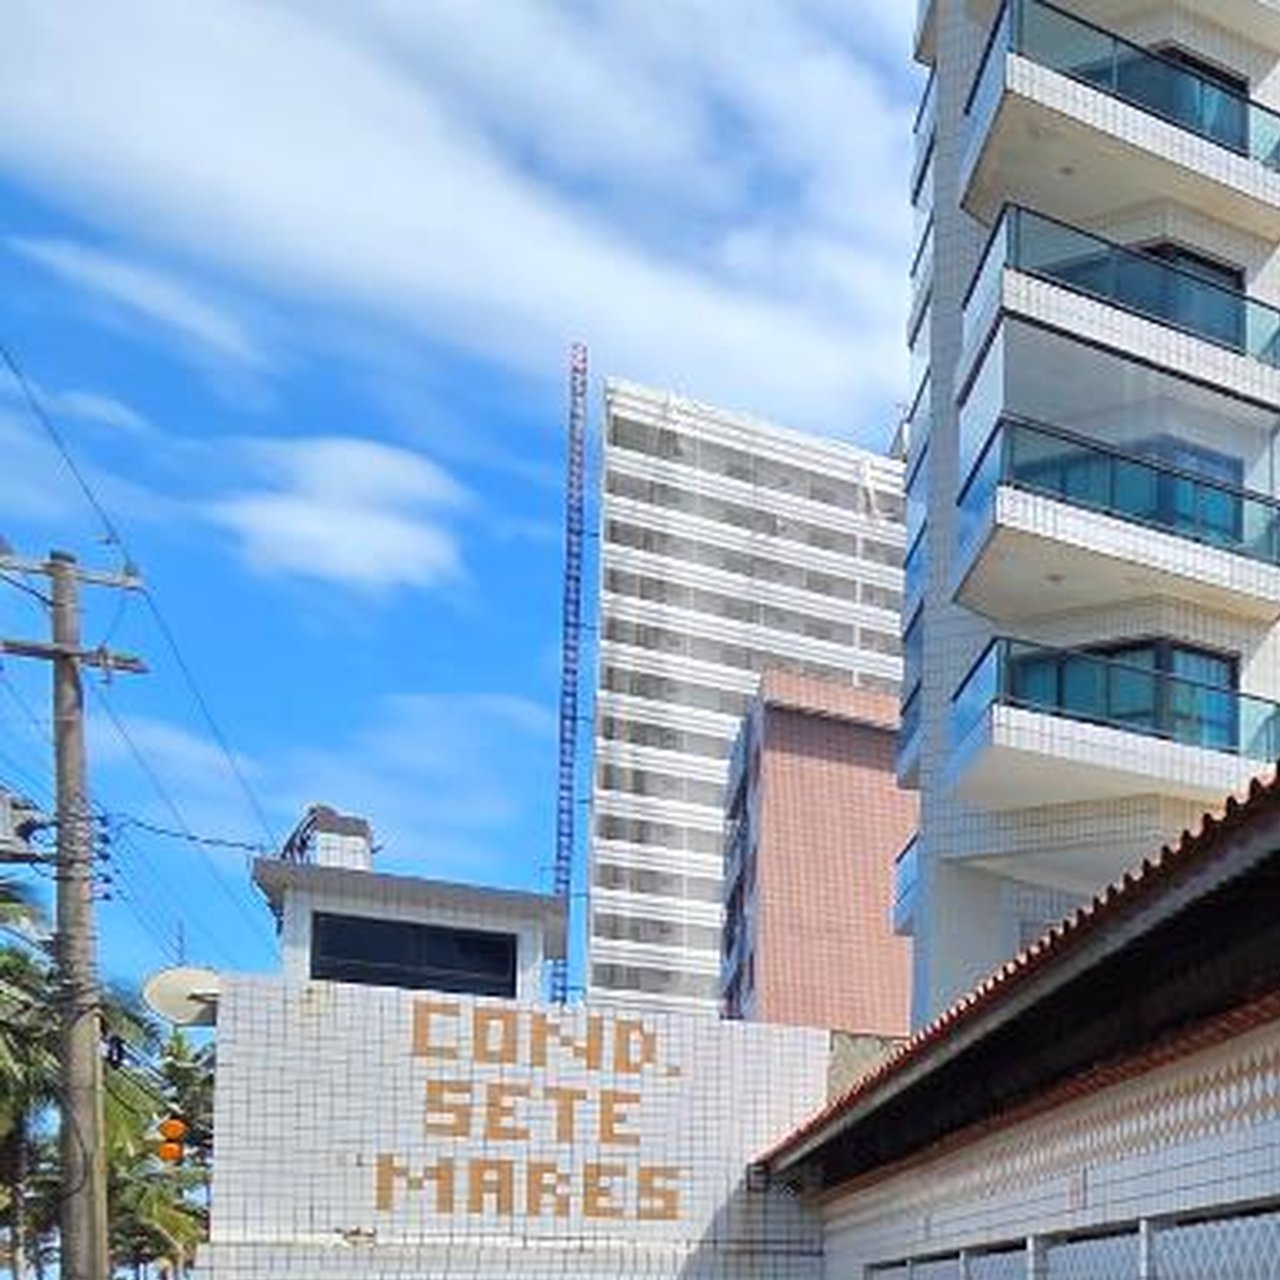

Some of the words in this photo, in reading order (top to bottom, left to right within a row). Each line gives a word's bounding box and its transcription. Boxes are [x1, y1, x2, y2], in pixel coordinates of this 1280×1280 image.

[411, 999, 682, 1077] COND.
[424, 1080, 641, 1146] SETE
[374, 1153, 694, 1221] MARES
